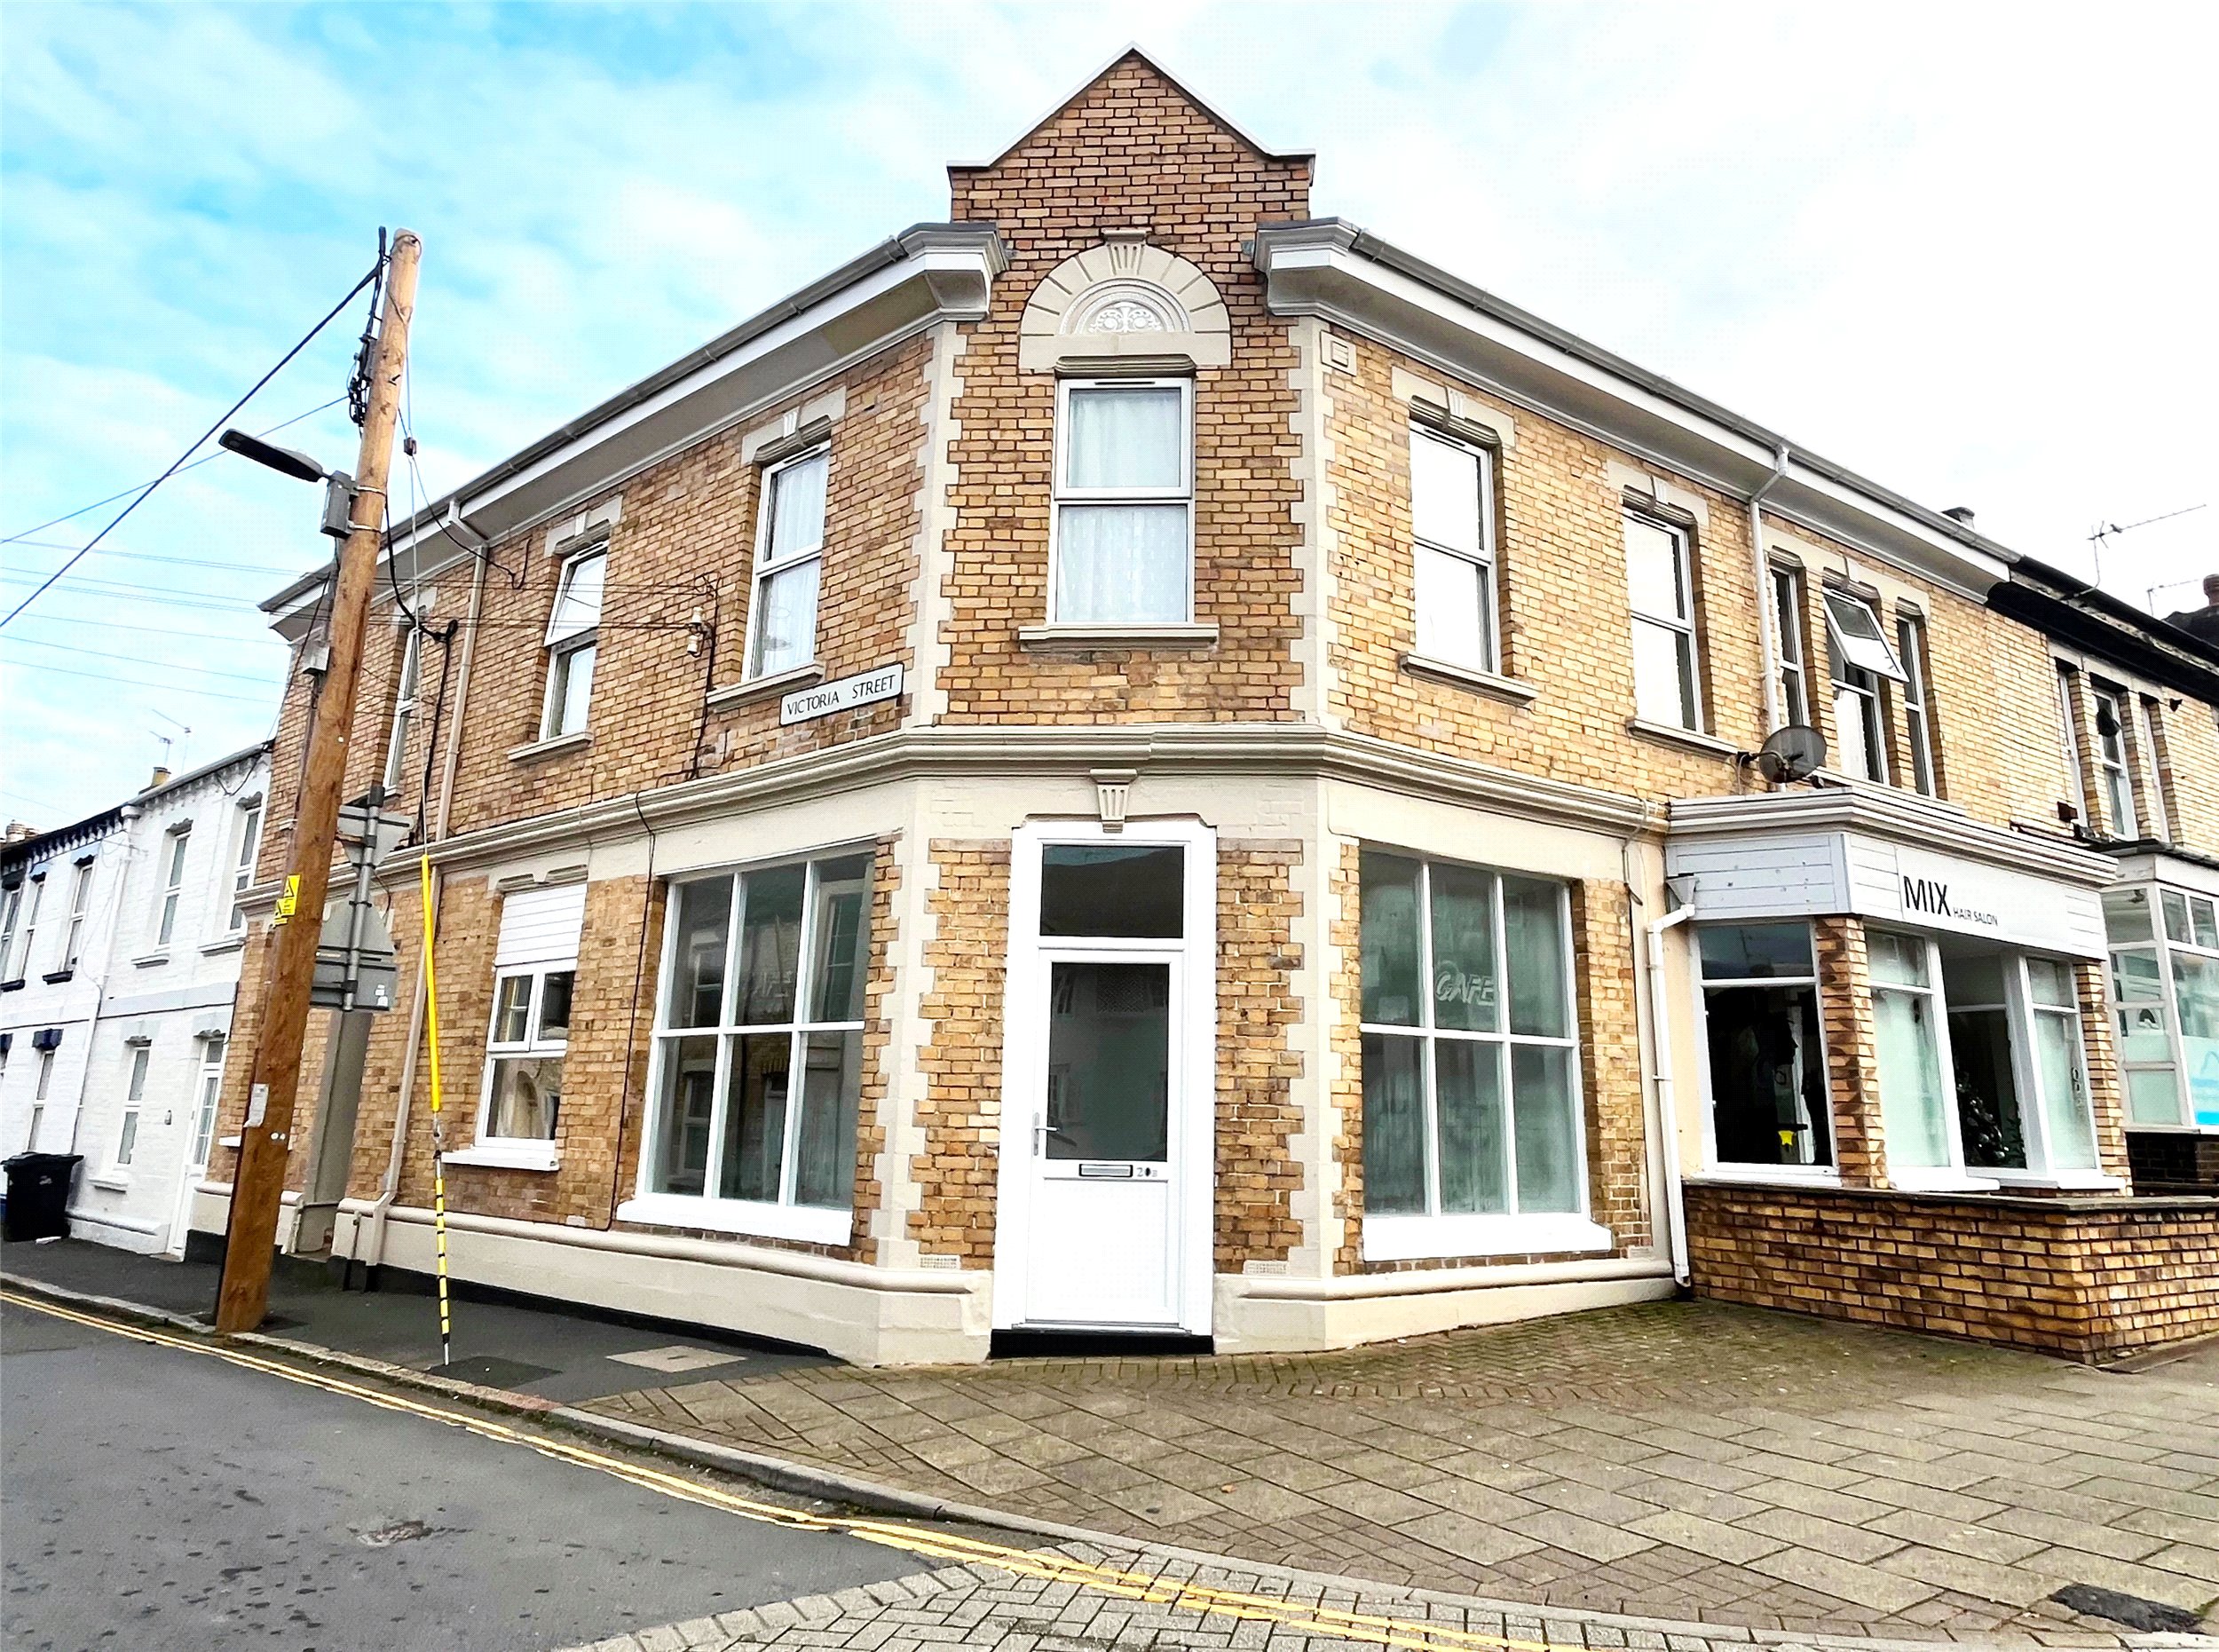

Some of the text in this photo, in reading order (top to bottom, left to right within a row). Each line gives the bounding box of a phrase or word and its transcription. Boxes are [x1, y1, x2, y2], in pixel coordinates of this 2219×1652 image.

[786, 674, 896, 715] VICTORIA STREET
[1903, 875, 1952, 917] MIX
[1953, 907, 1998, 926] HAIR SALON
